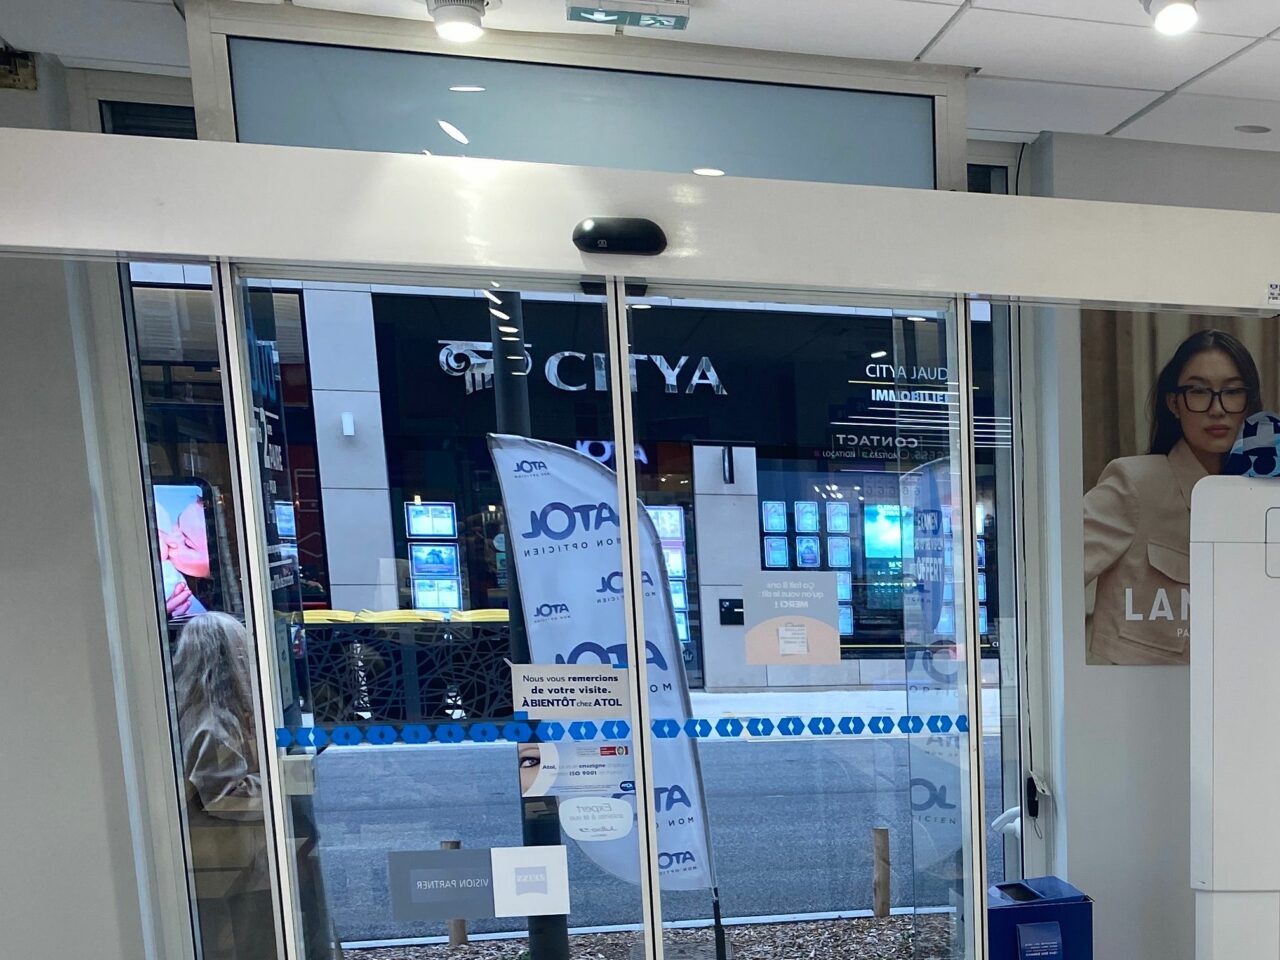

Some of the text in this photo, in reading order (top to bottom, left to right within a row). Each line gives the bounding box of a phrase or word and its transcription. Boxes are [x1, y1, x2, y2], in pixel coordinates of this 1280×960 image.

[544, 351, 728, 395] CITYA
[866, 364, 907, 379] CITYA
[531, 686, 612, 694] de votre visite.
[522, 696, 530, 707] À
[531, 696, 577, 707] BIENTÔT
[593, 698, 623, 707] ATOL
